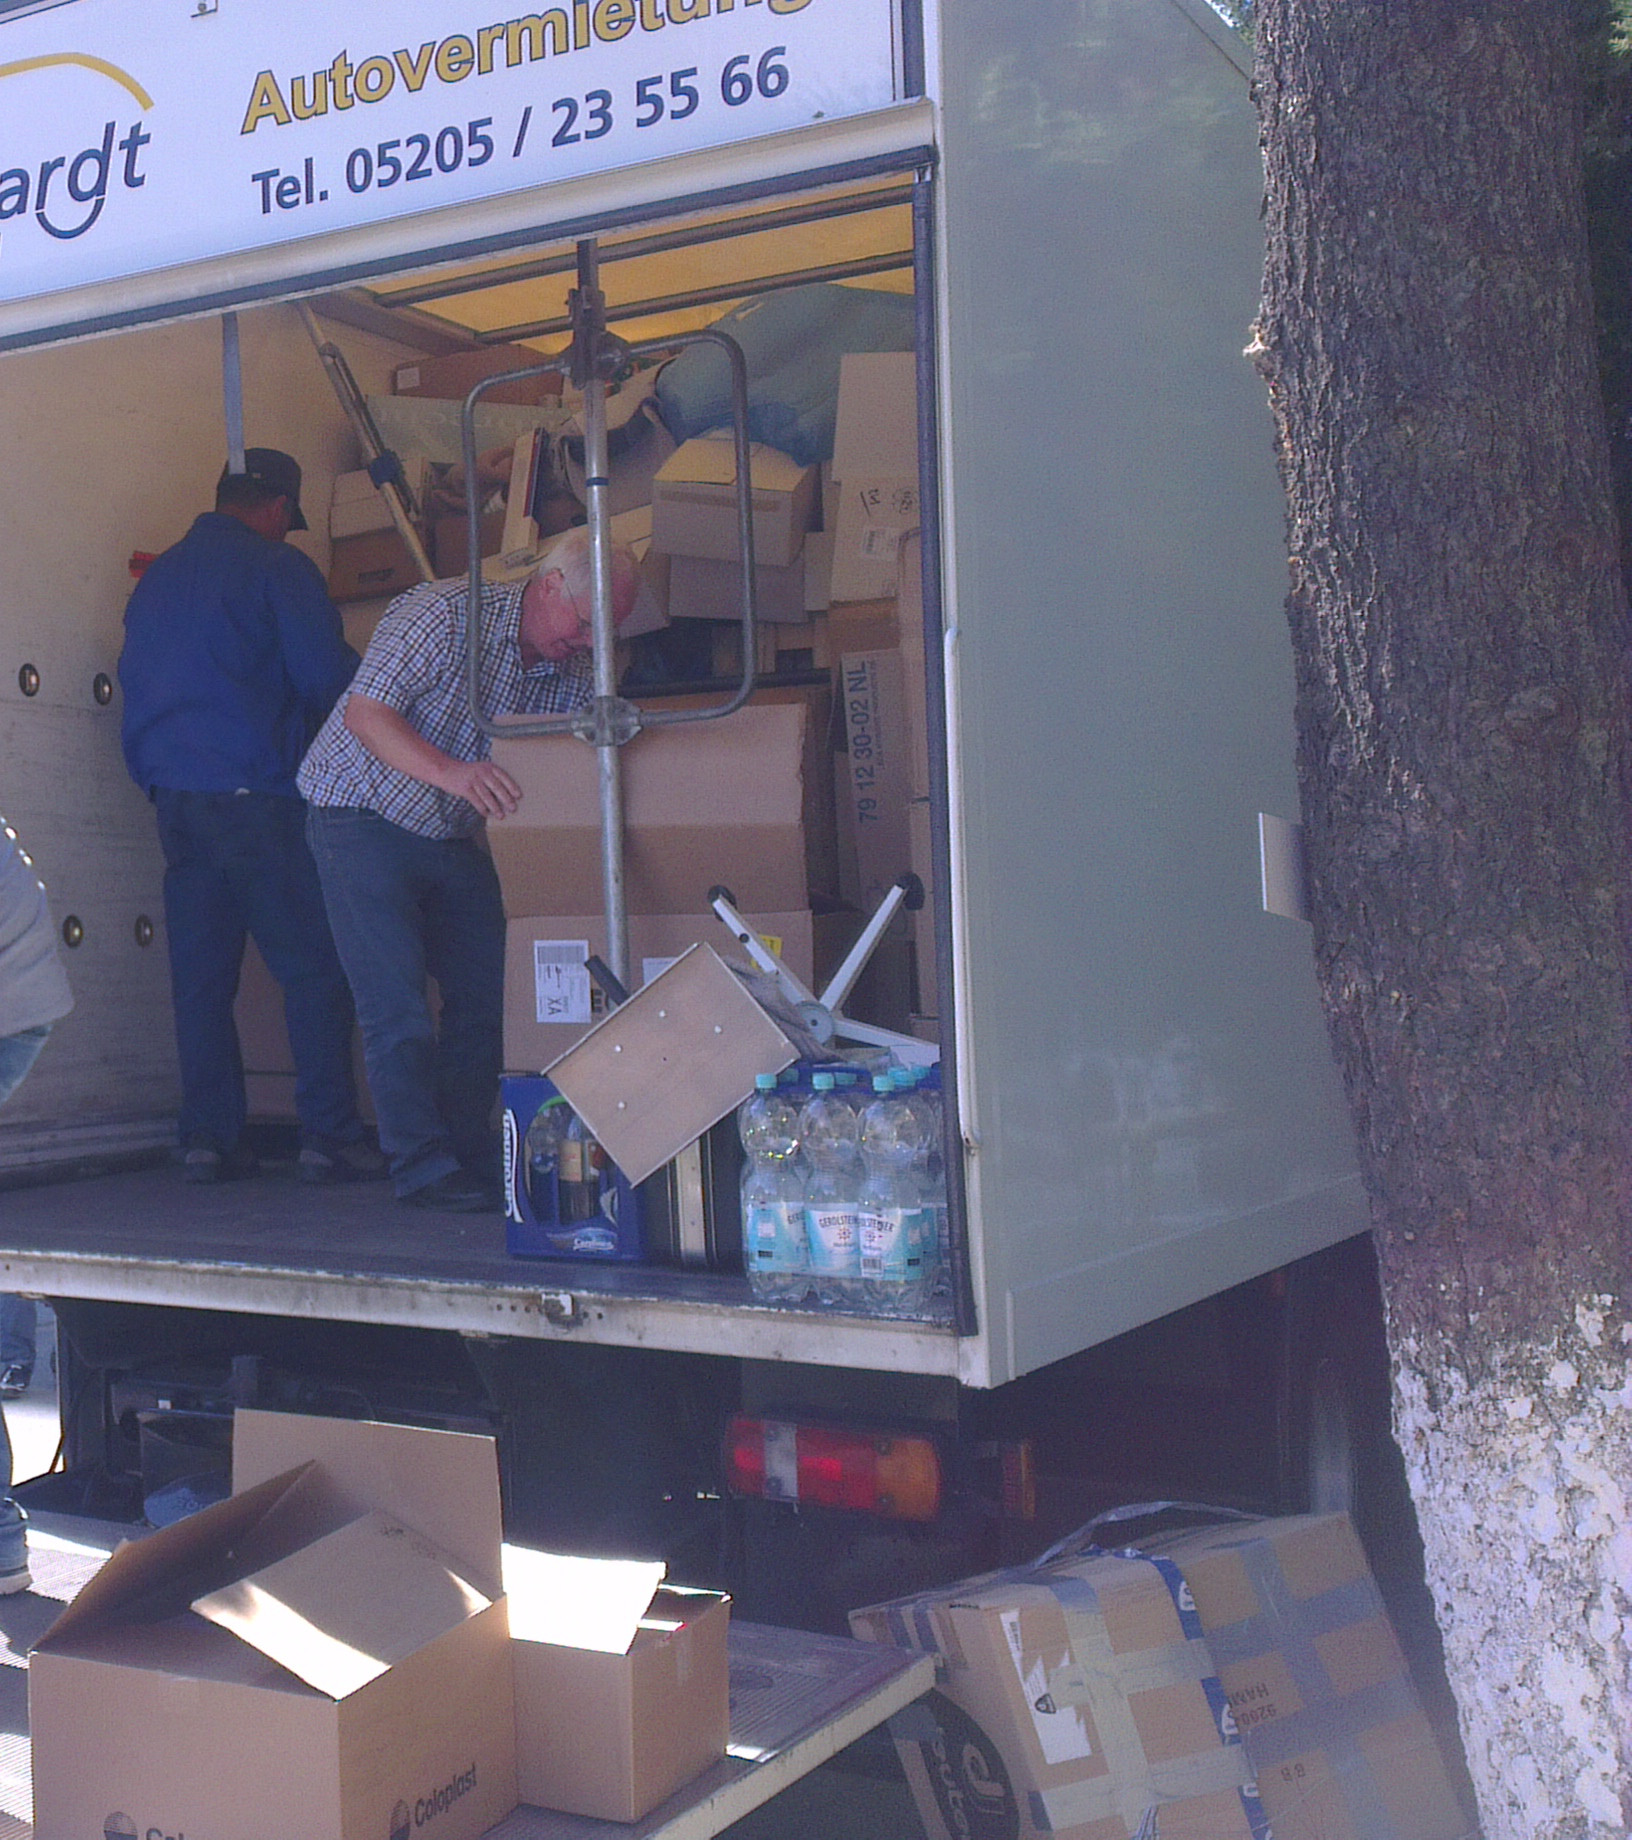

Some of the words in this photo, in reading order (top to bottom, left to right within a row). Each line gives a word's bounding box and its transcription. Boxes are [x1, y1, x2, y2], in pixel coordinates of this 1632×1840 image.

[241, 0, 813, 135] Autovermietu
[252, 157, 329, 214] Tel.
[346, 117, 495, 194] 05205
[513, 107, 533, 157] /
[551, 89, 615, 147] 23
[636, 67, 700, 128] 55
[721, 46, 790, 106] 66
[847, 661, 867, 693] NL
[415, 1761, 477, 1828] Coloplast
